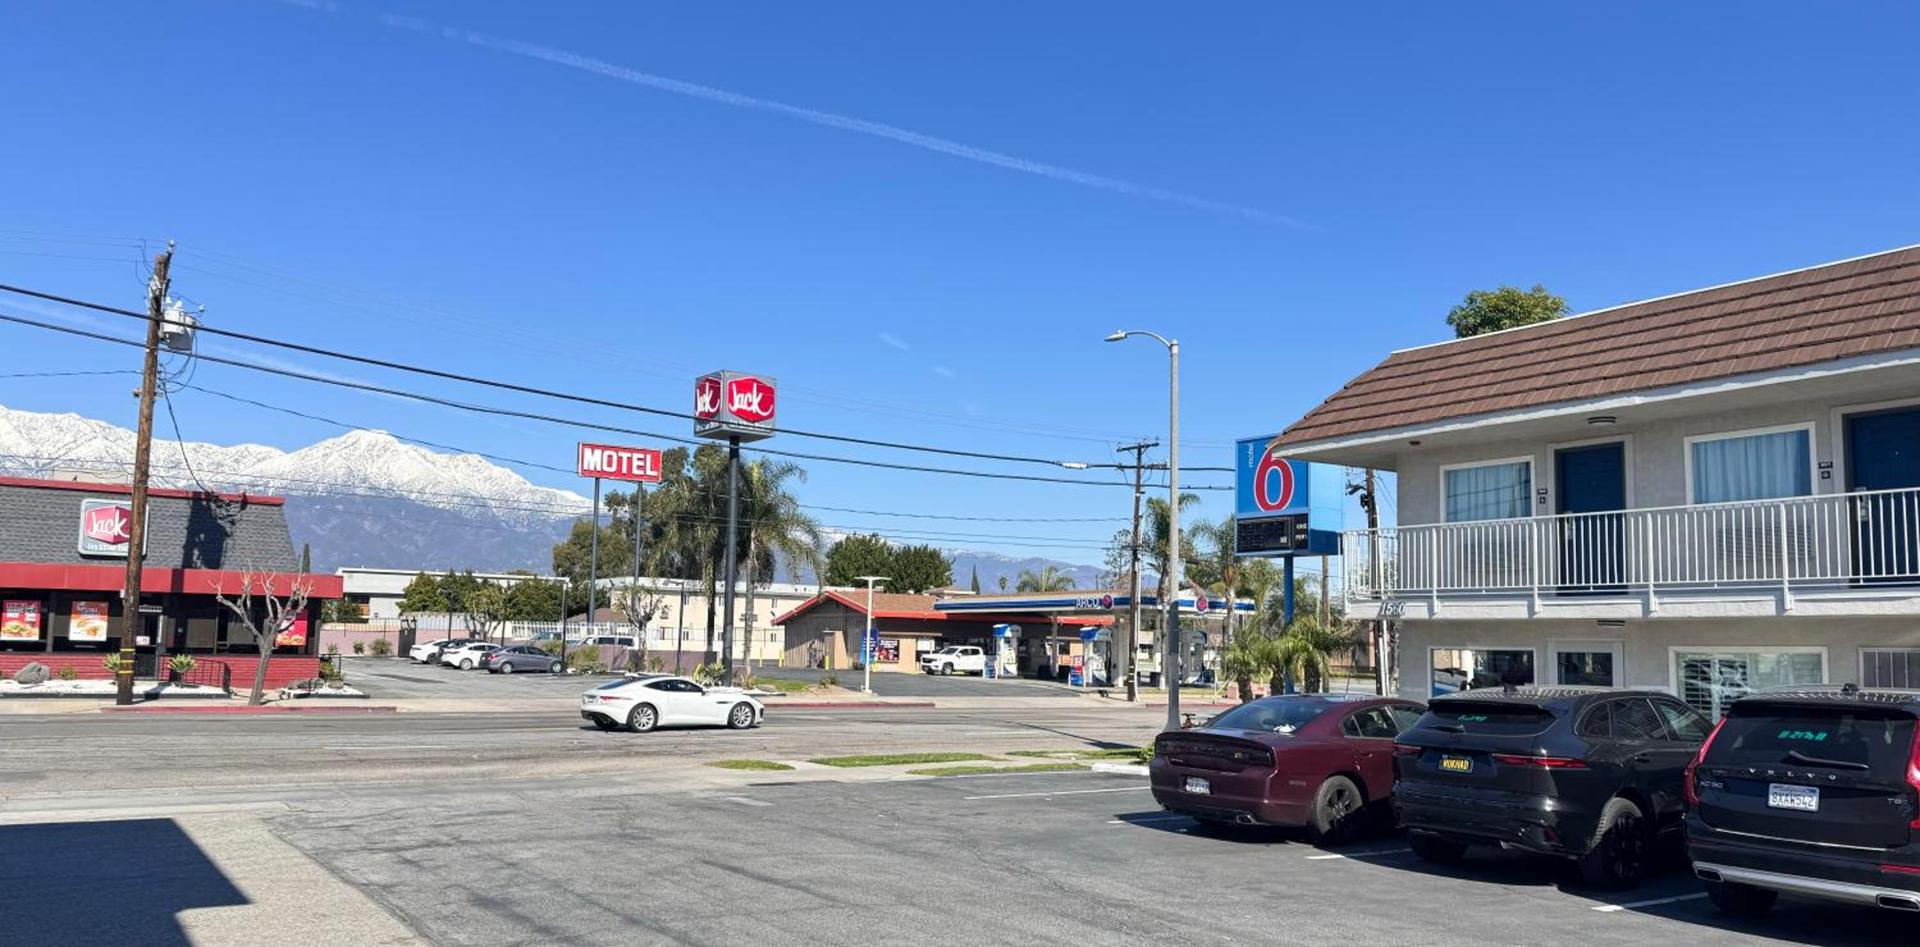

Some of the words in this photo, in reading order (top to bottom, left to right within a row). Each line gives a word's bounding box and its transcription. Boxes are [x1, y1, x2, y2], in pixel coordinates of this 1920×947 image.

[729, 382, 773, 416] Jack
[583, 447, 658, 476] MOTEL
[1254, 446, 1295, 512] 6
[87, 509, 131, 538] Jack
[1075, 597, 1100, 608] ARCO
[1748, 768, 1838, 780] VOLVO
